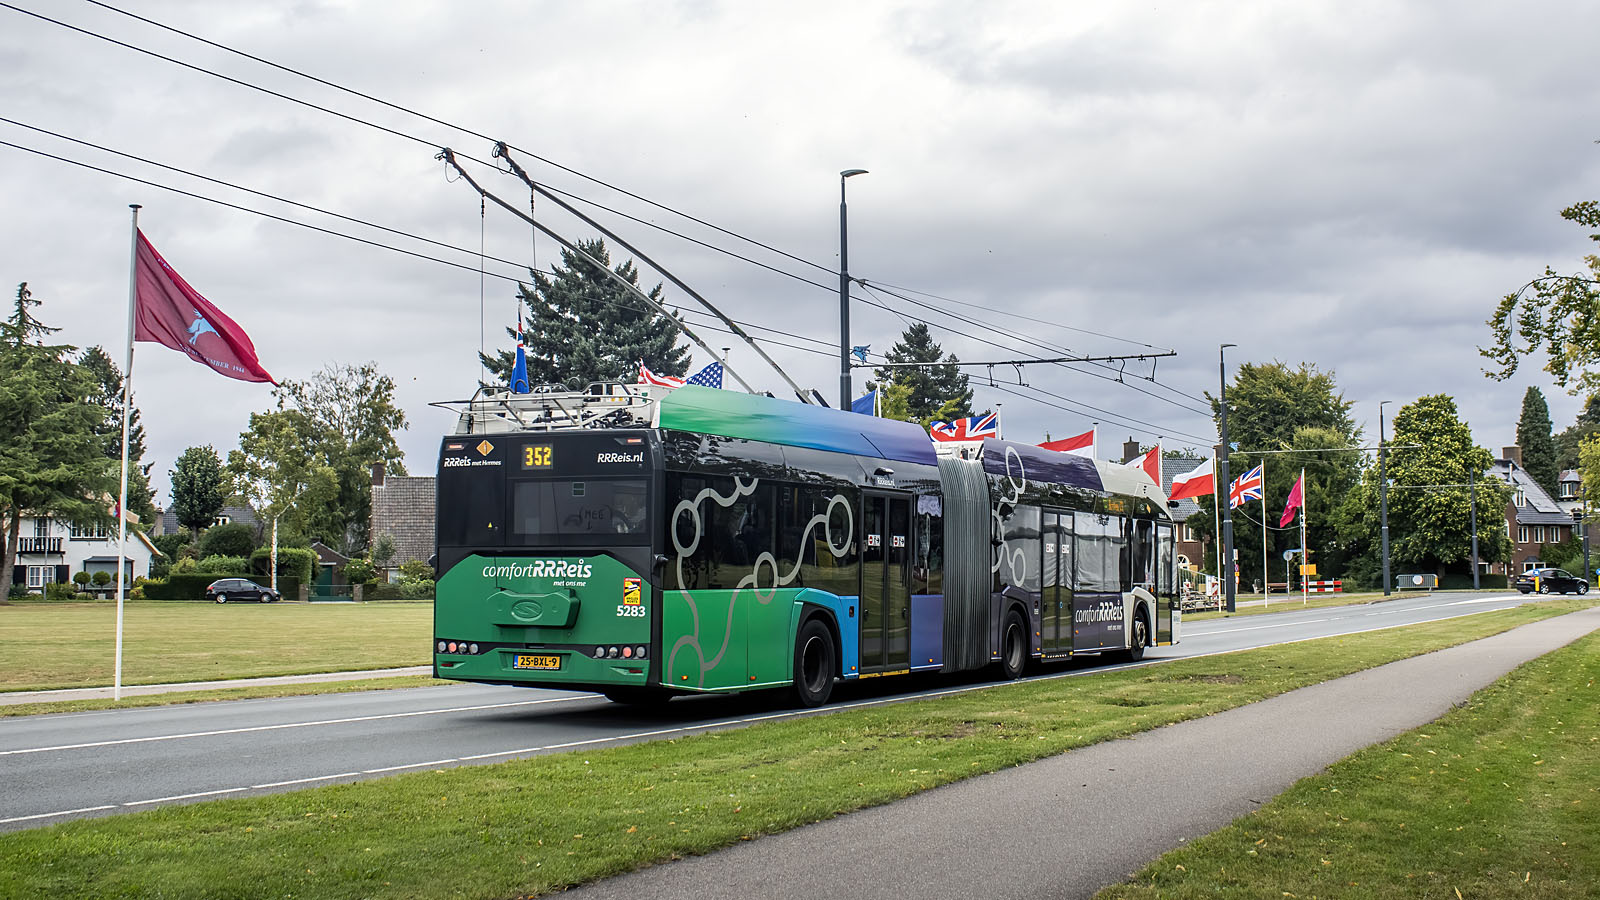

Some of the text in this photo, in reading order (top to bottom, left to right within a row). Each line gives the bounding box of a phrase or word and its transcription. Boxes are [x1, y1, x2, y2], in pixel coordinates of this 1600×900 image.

[443, 456, 472, 467] RRReis
[525, 447, 552, 466] 352
[597, 452, 644, 463] RRReis.nl
[482, 559, 593, 580] comfortRRReis
[616, 605, 646, 617] 5283
[1075, 599, 1123, 626] comfortRRReis
[520, 657, 558, 667] 25-BXL-9
